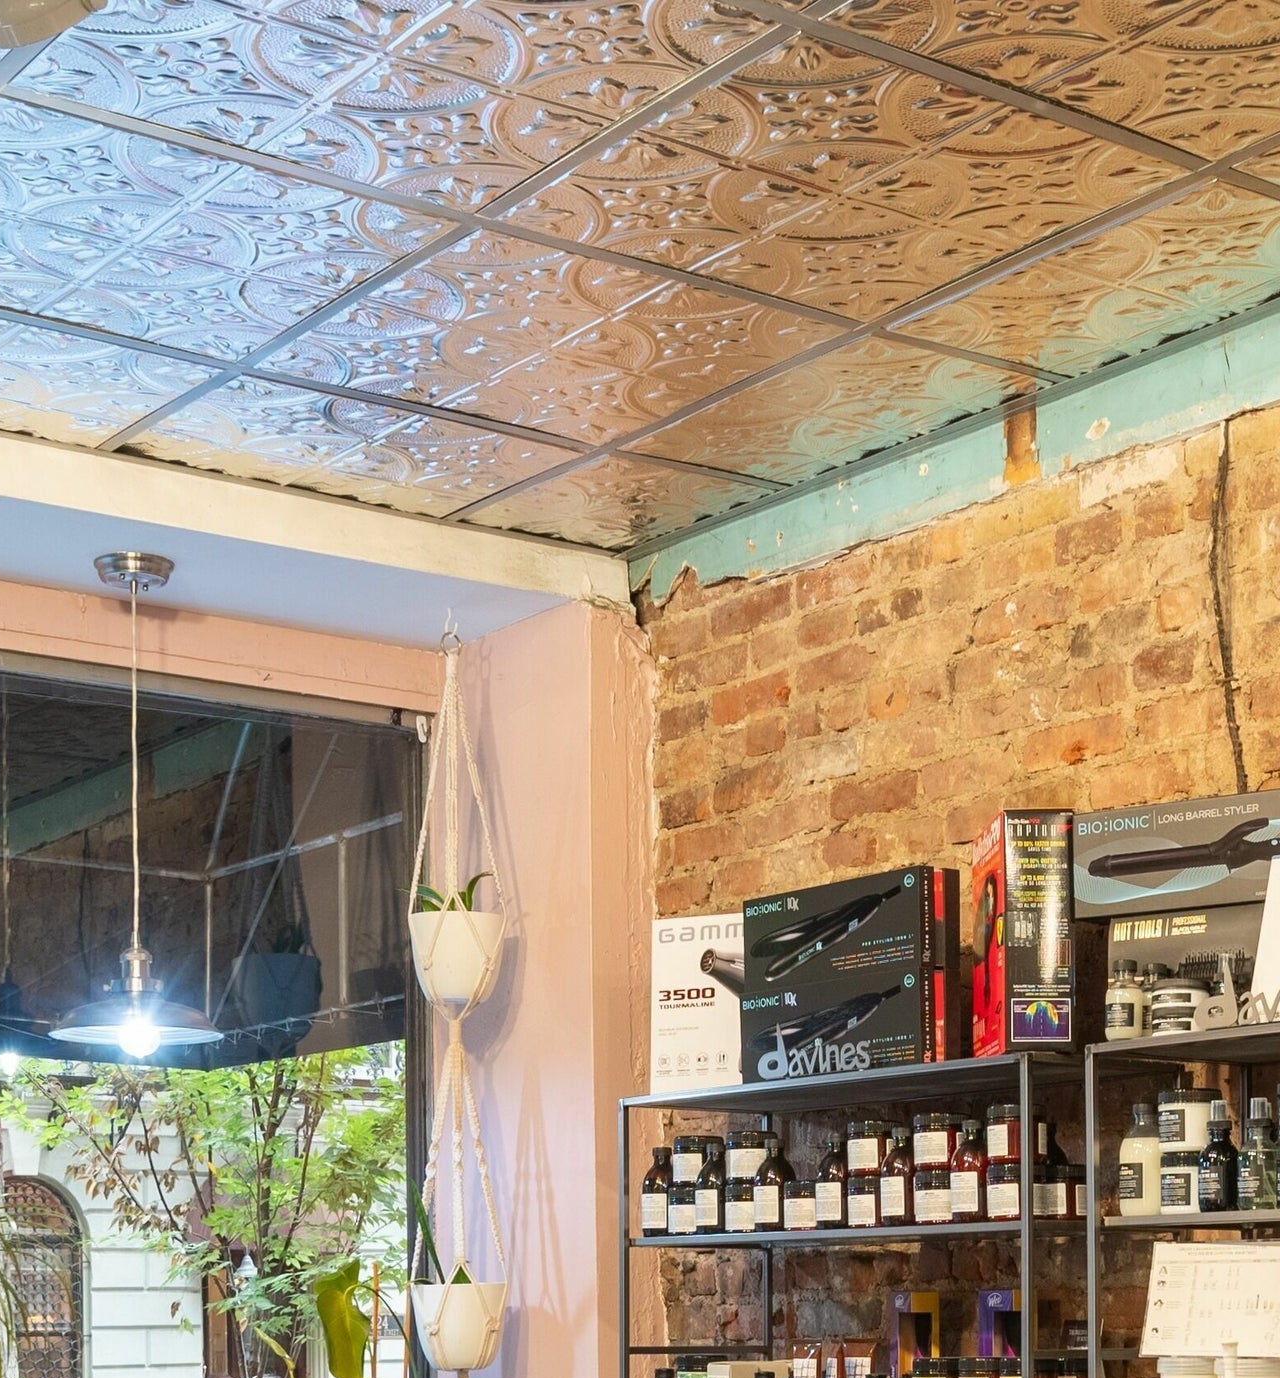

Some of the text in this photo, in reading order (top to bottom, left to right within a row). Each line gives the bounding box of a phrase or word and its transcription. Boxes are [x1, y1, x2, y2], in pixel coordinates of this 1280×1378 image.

[1158, 812, 1184, 825] LONG
[1185, 807, 1222, 822] BARREL
[1224, 803, 1260, 817] STYLER
[1113, 921, 1131, 942] HOT
[1132, 919, 1162, 940] TOOLS
[658, 986, 716, 1002] 3500
[659, 1001, 716, 1010] TOURMALINE
[757, 1022, 870, 1080] davines
